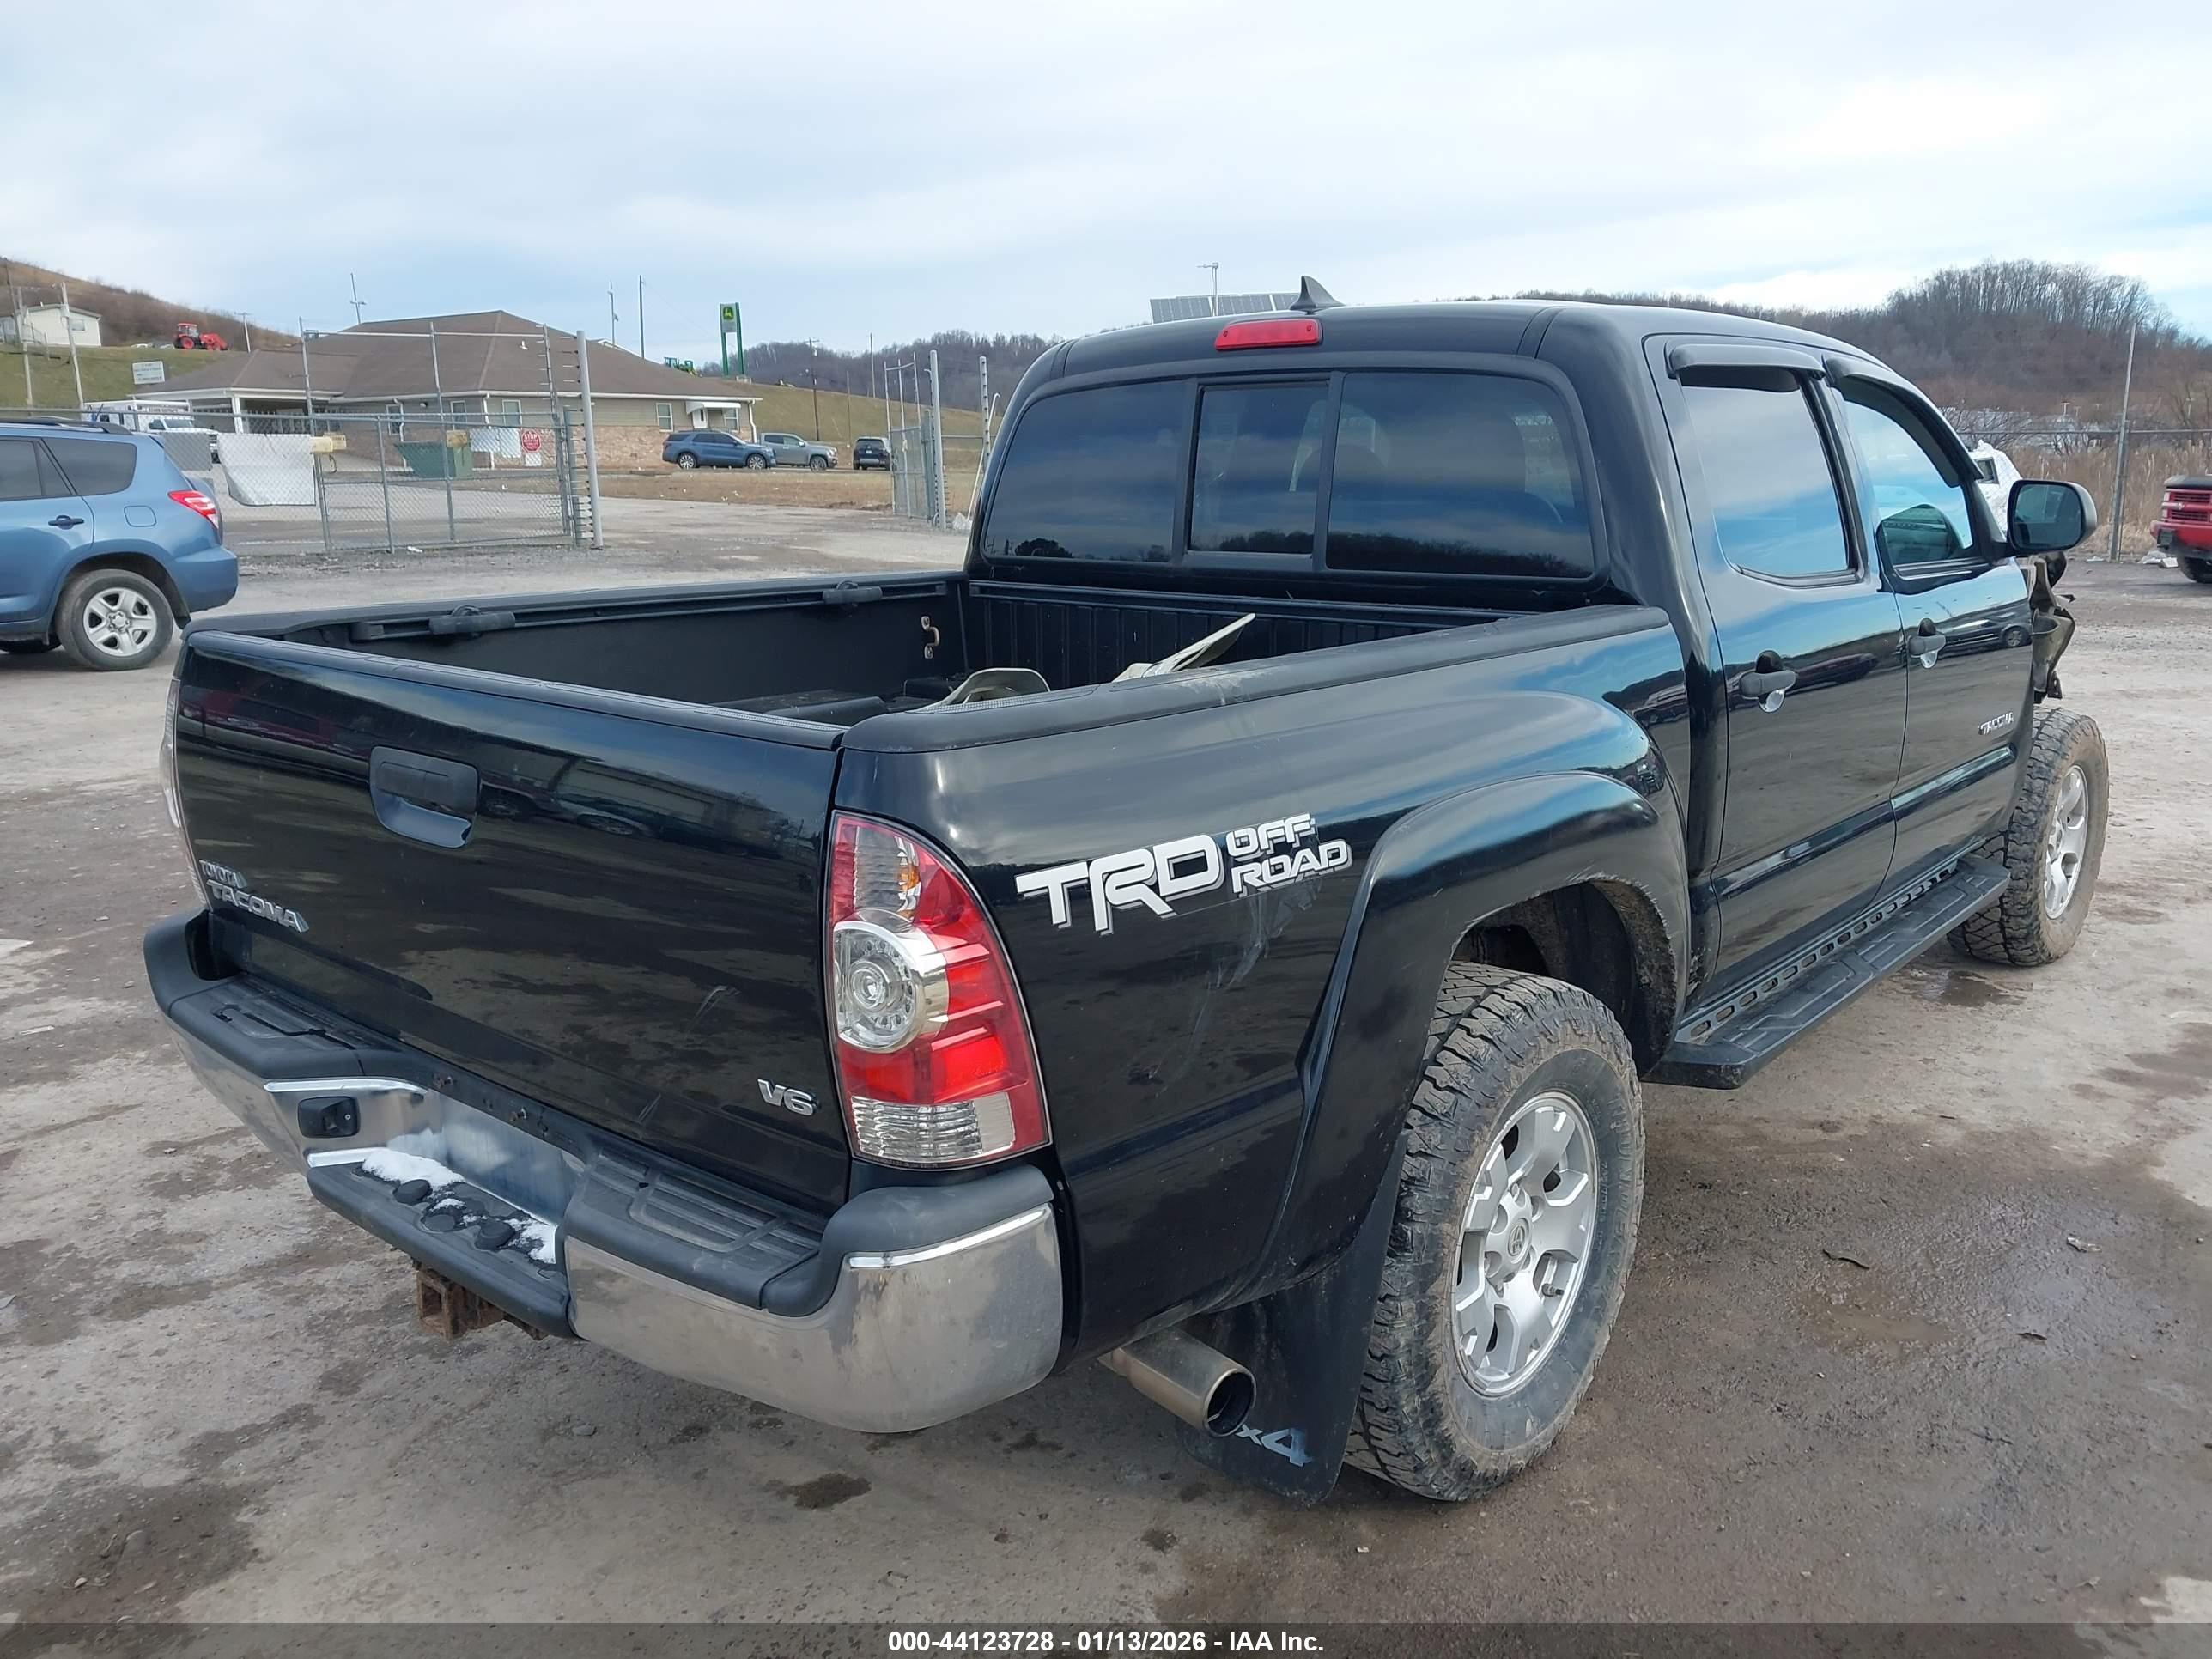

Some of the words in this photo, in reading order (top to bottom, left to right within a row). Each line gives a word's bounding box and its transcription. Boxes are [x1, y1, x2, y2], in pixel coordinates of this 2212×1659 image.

[1225, 812, 1316, 862] OFF
[199, 860, 248, 889] TOYOTA
[1015, 834, 1224, 936] TRD
[1230, 838, 1352, 898] ROAD
[206, 879, 310, 933] TACOMA
[757, 1079, 814, 1115] V6
